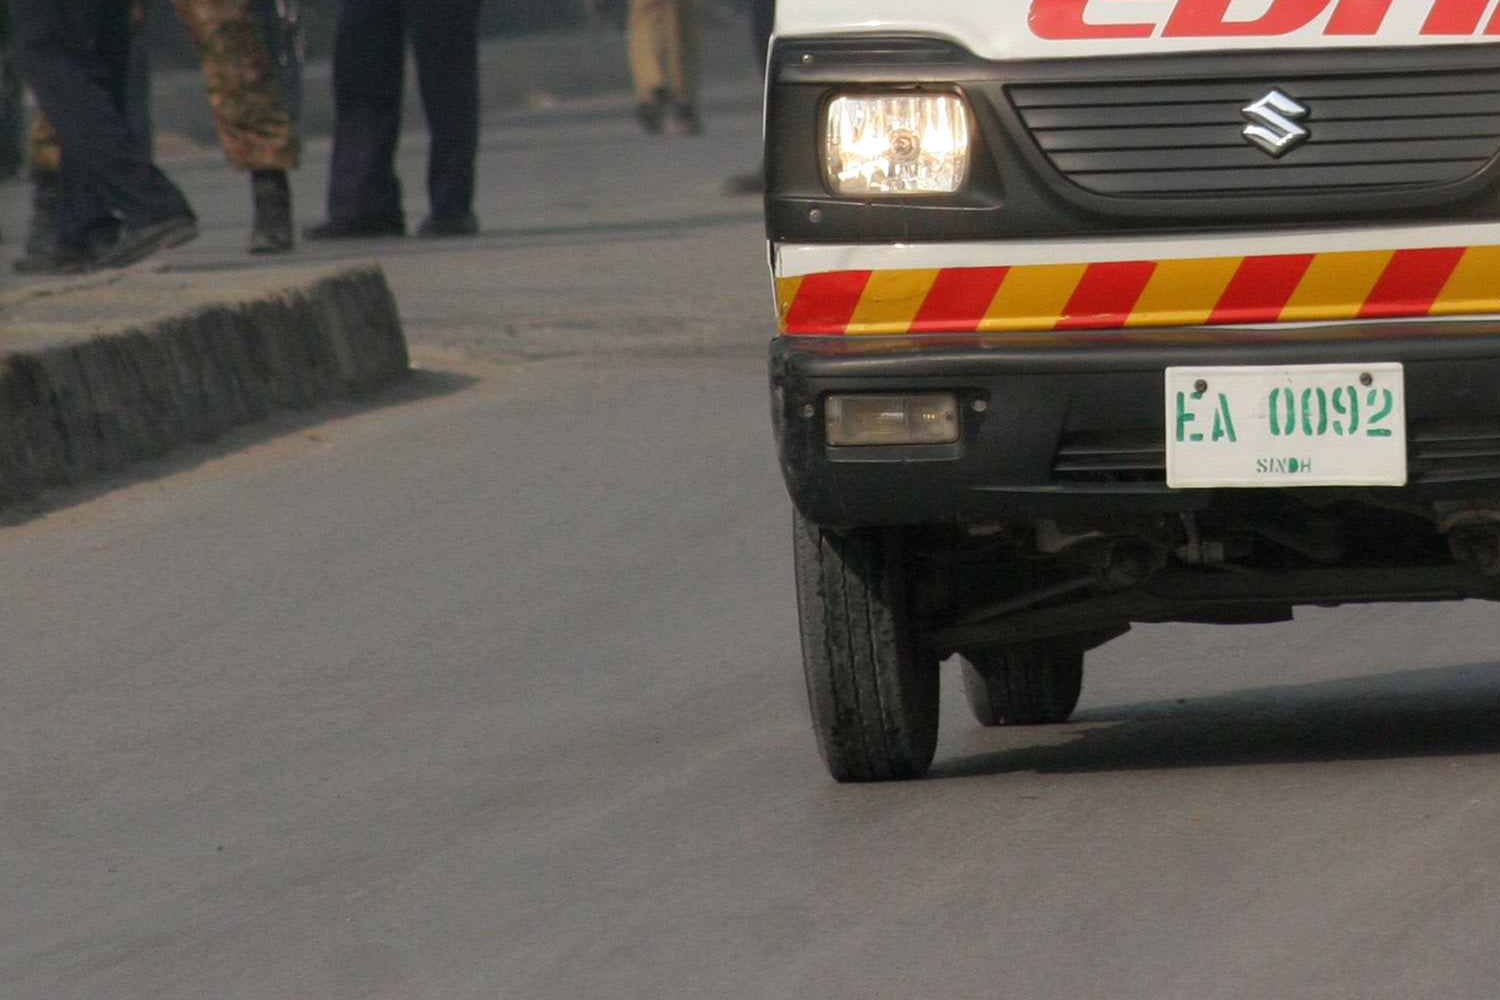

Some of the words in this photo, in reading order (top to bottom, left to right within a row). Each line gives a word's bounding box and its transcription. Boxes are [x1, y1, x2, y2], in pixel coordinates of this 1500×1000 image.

[1176, 391, 1237, 442] EA
[1269, 386, 1393, 436] 0092
[1256, 457, 1311, 474] SINDH
